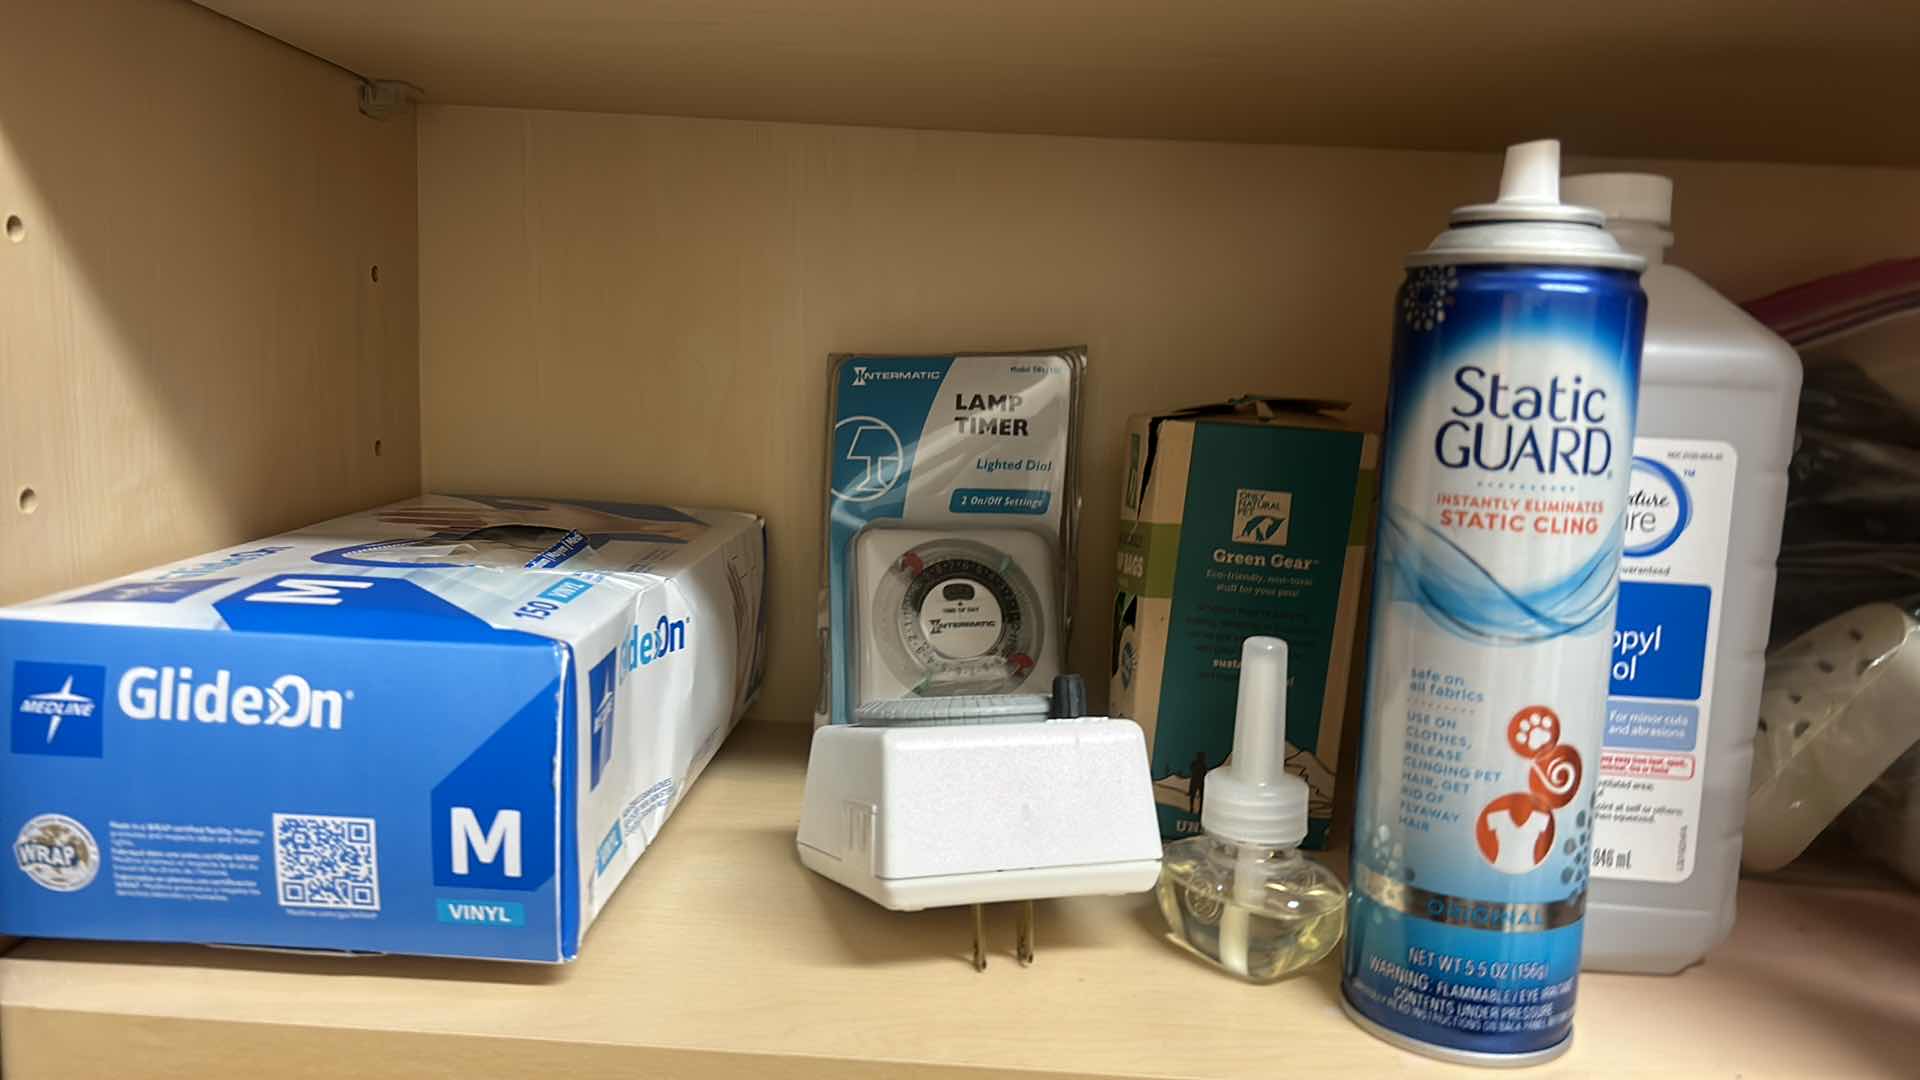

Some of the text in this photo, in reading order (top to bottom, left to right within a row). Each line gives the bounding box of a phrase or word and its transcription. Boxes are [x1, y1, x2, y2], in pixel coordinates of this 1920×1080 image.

[852, 366, 941, 386] INTERMATIC
[955, 393, 1023, 413] LAMP
[1451, 365, 1607, 423] Static
[954, 416, 1028, 436] TIMER
[1434, 420, 1612, 476] GUARD
[976, 456, 1052, 473] Lighted Dial
[971, 495, 1003, 507] On/Off
[1005, 497, 1044, 509] Settings
[1436, 493, 1605, 514] INSTANTLY ELIMINATES
[1440, 510, 1600, 535] STATIC CLING
[1213, 548, 1314, 572] Green Gear
[1621, 565, 1671, 577] uaranteed
[1239, 583, 1253, 596] for
[1252, 586, 1277, 599] your
[513, 600, 560, 620] 150
[1411, 668, 1465, 686] safe on
[118, 666, 345, 730] GlideOn
[1430, 683, 1485, 703] fabrics
[19, 698, 95, 718] MEDLINE
[1609, 709, 1689, 726] For minor cuts
[1407, 711, 1457, 729] USE ON
[1406, 726, 1472, 750] CLOTHES,
[1608, 724, 1686, 737] and abrasions
[1405, 741, 1463, 762] RELEASE
[1403, 756, 1504, 783] CLINGING PET
[1402, 771, 1471, 795] HAIR, GET
[1402, 785, 1445, 803] RID OF
[1400, 799, 1460, 823] FLYAWAY
[1399, 815, 1431, 833] HAIR
[450, 806, 522, 878] M
[20, 842, 77, 867] WRAP
[1592, 847, 1615, 867] 946
[448, 903, 513, 923] VINYL
[1427, 898, 1545, 926] ORIGINAL
[1408, 946, 1436, 967] NET
[1438, 954, 1462, 974] WT
[1490, 960, 1511, 979] OZ
[1393, 986, 1456, 1015] CONTENTS
[1456, 1000, 1500, 1020] UNDER
